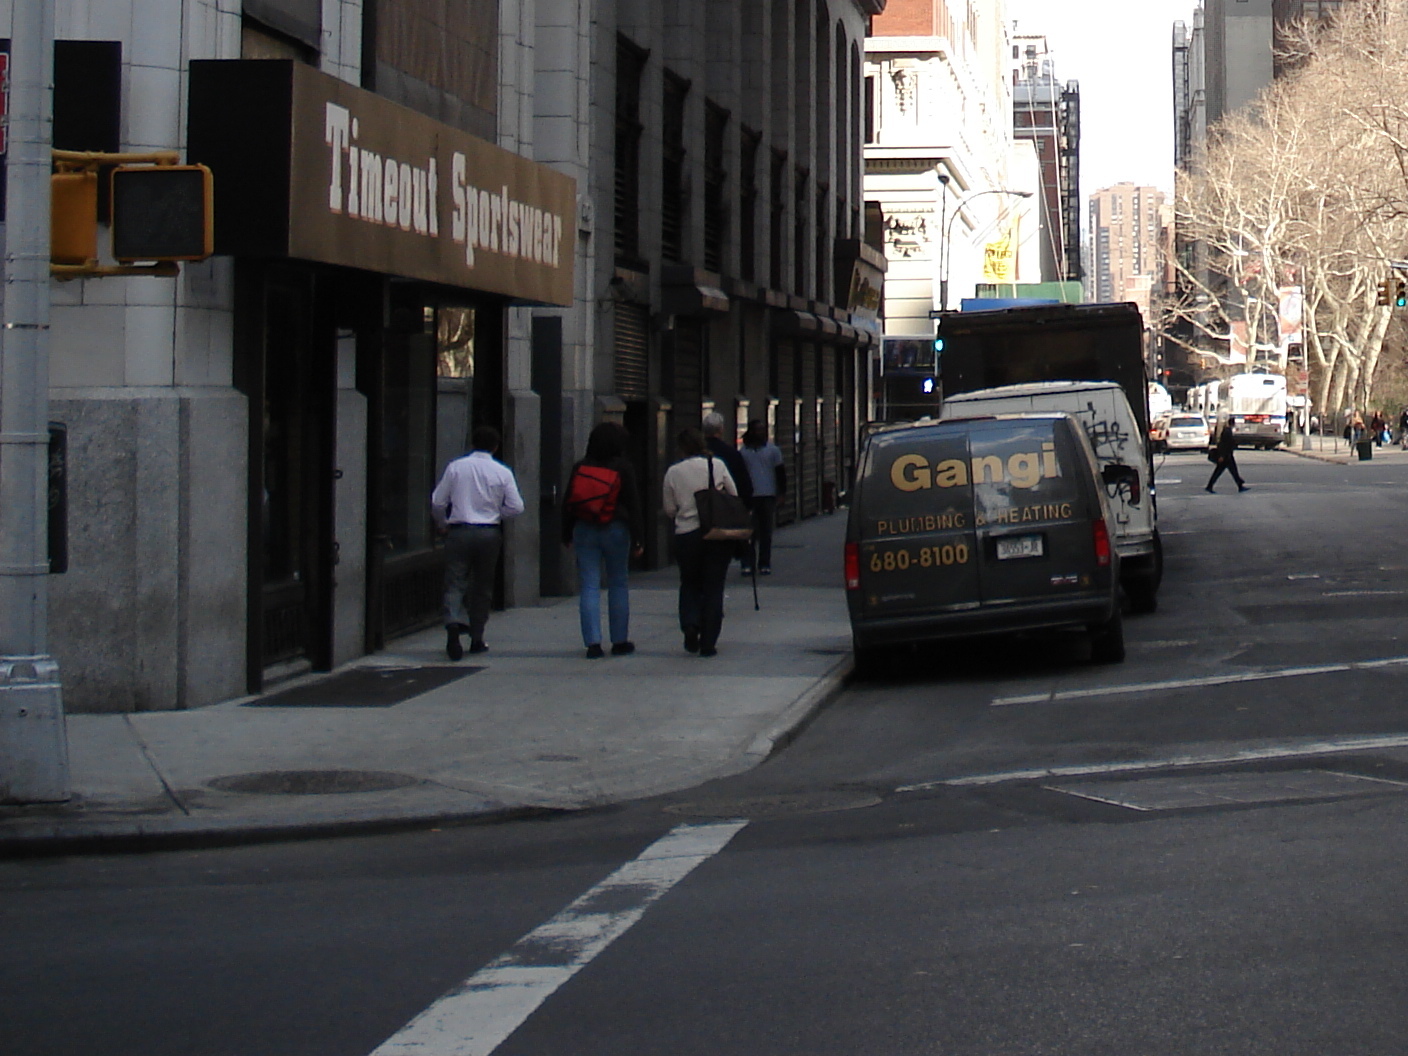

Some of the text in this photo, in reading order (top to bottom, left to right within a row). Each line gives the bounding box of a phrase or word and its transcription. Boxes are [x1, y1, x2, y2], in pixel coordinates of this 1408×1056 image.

[325, 101, 562, 269] Timeout Sportswear
[890, 442, 1056, 492] Gangi
[877, 513, 966, 536] PLUMBING
[997, 503, 1073, 524] HEATING
[869, 544, 969, 572] 680-8100
